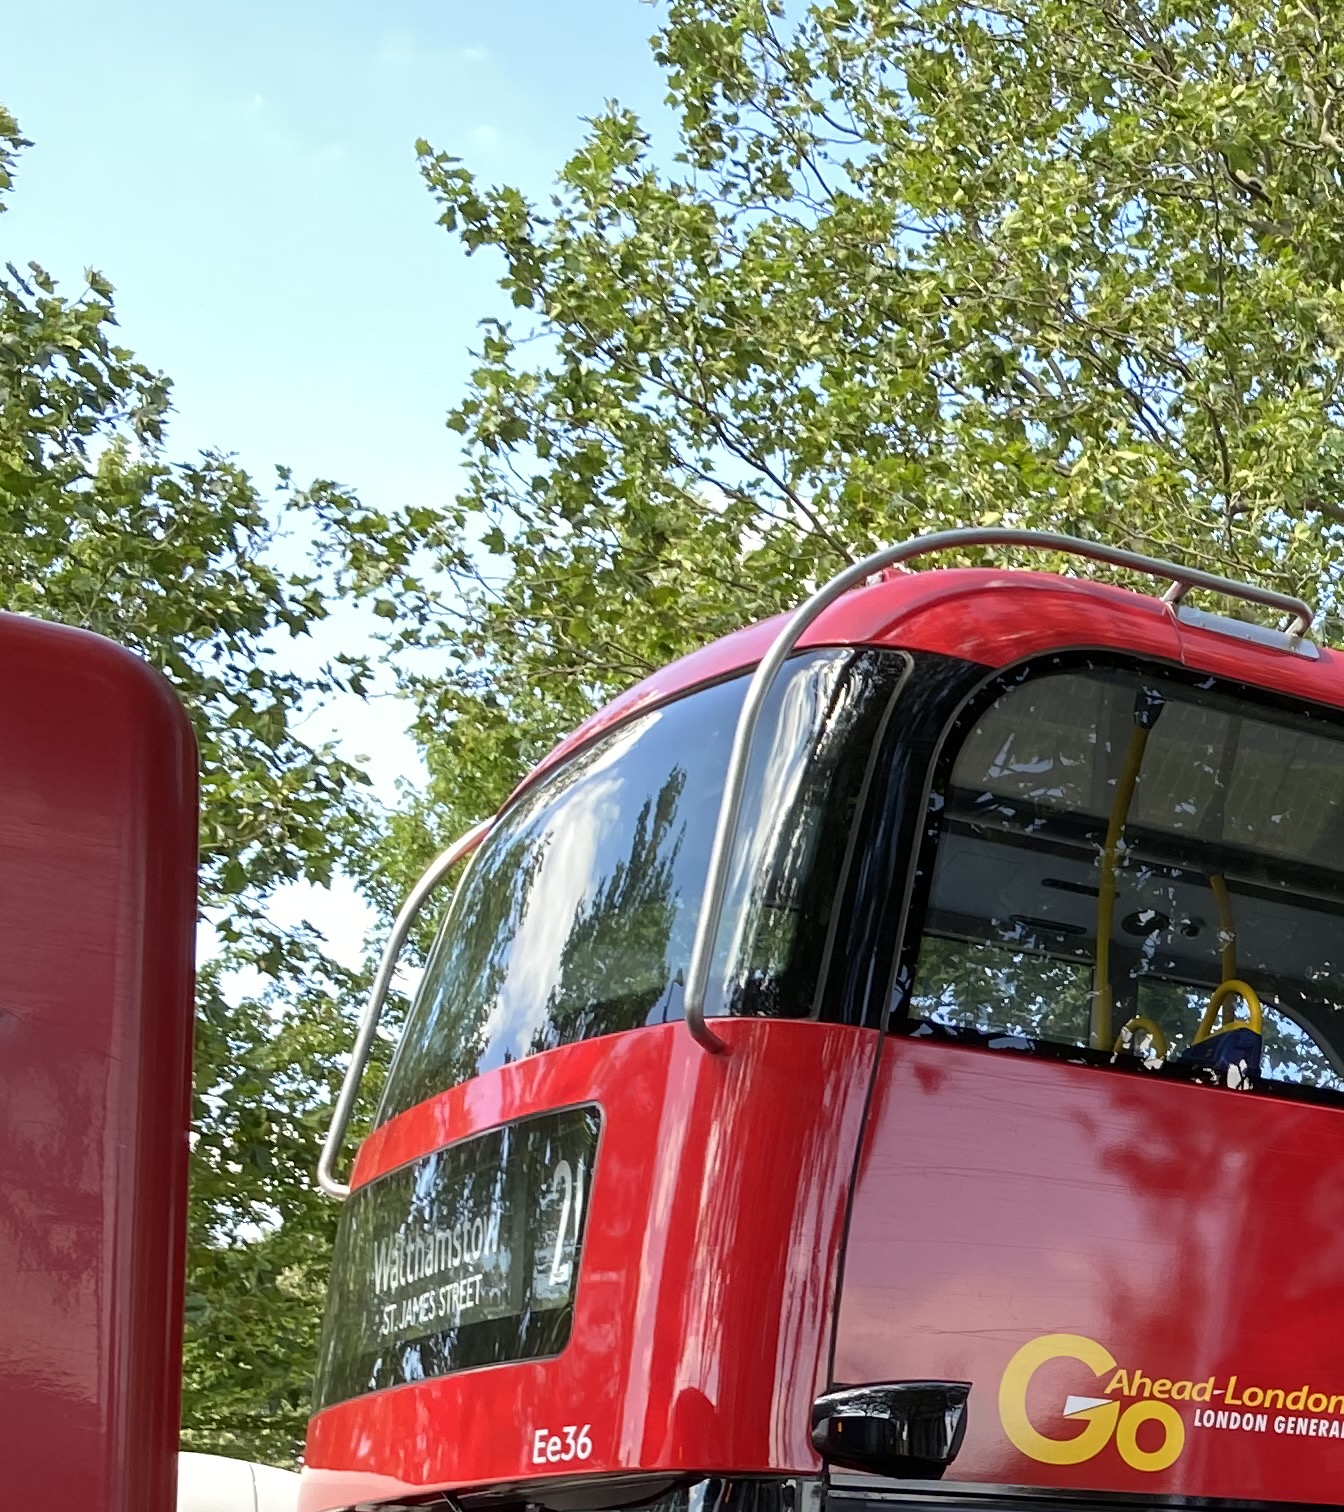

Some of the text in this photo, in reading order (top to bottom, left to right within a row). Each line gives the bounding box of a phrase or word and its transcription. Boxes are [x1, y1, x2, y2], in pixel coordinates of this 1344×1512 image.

[382, 1274, 483, 1335] ST. JAMES STREET
[999, 1333, 1185, 1473] Go
[1193, 1408, 1268, 1433] LONDON
[532, 1424, 593, 1464] Ee36
